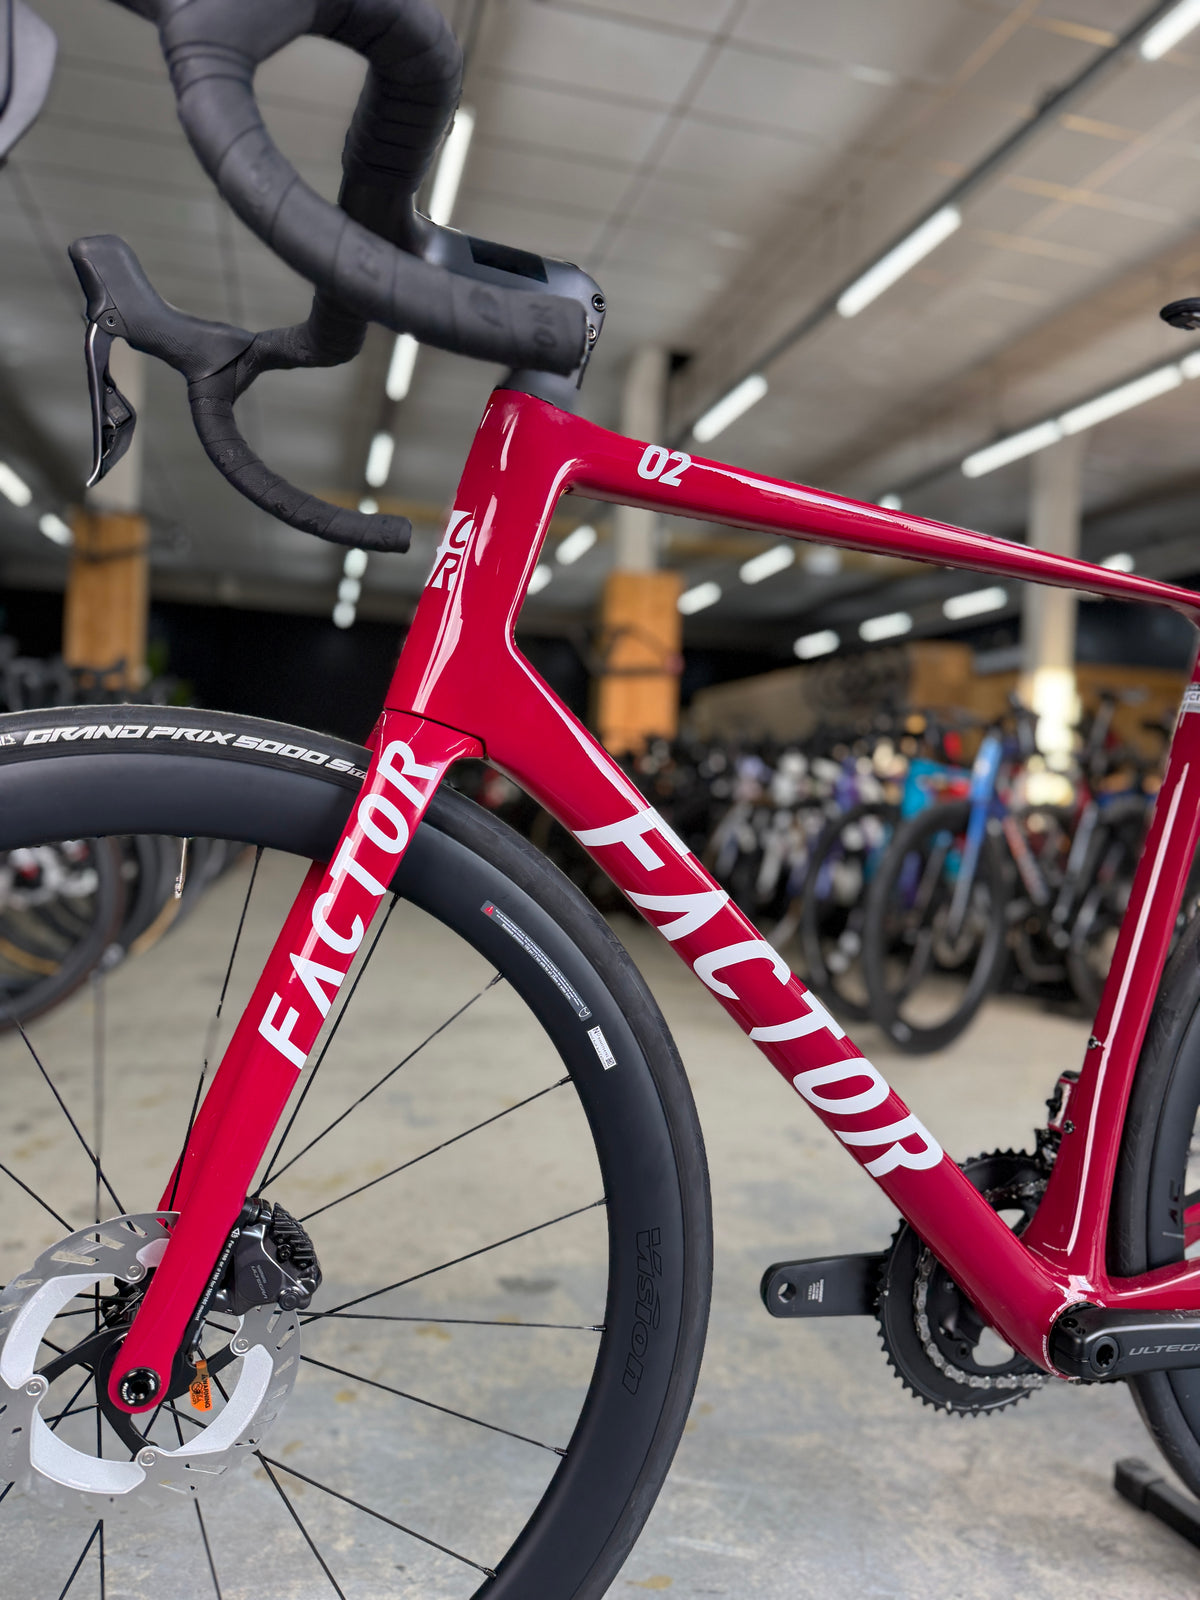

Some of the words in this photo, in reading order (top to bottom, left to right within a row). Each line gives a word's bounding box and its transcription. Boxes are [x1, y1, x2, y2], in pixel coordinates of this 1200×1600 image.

[23, 725, 148, 746] GRAND
[147, 727, 236, 746] PRIX
[232, 734, 330, 766] 5000
[258, 740, 438, 1070] FACTOR
[571, 806, 944, 1178] FACTOR
